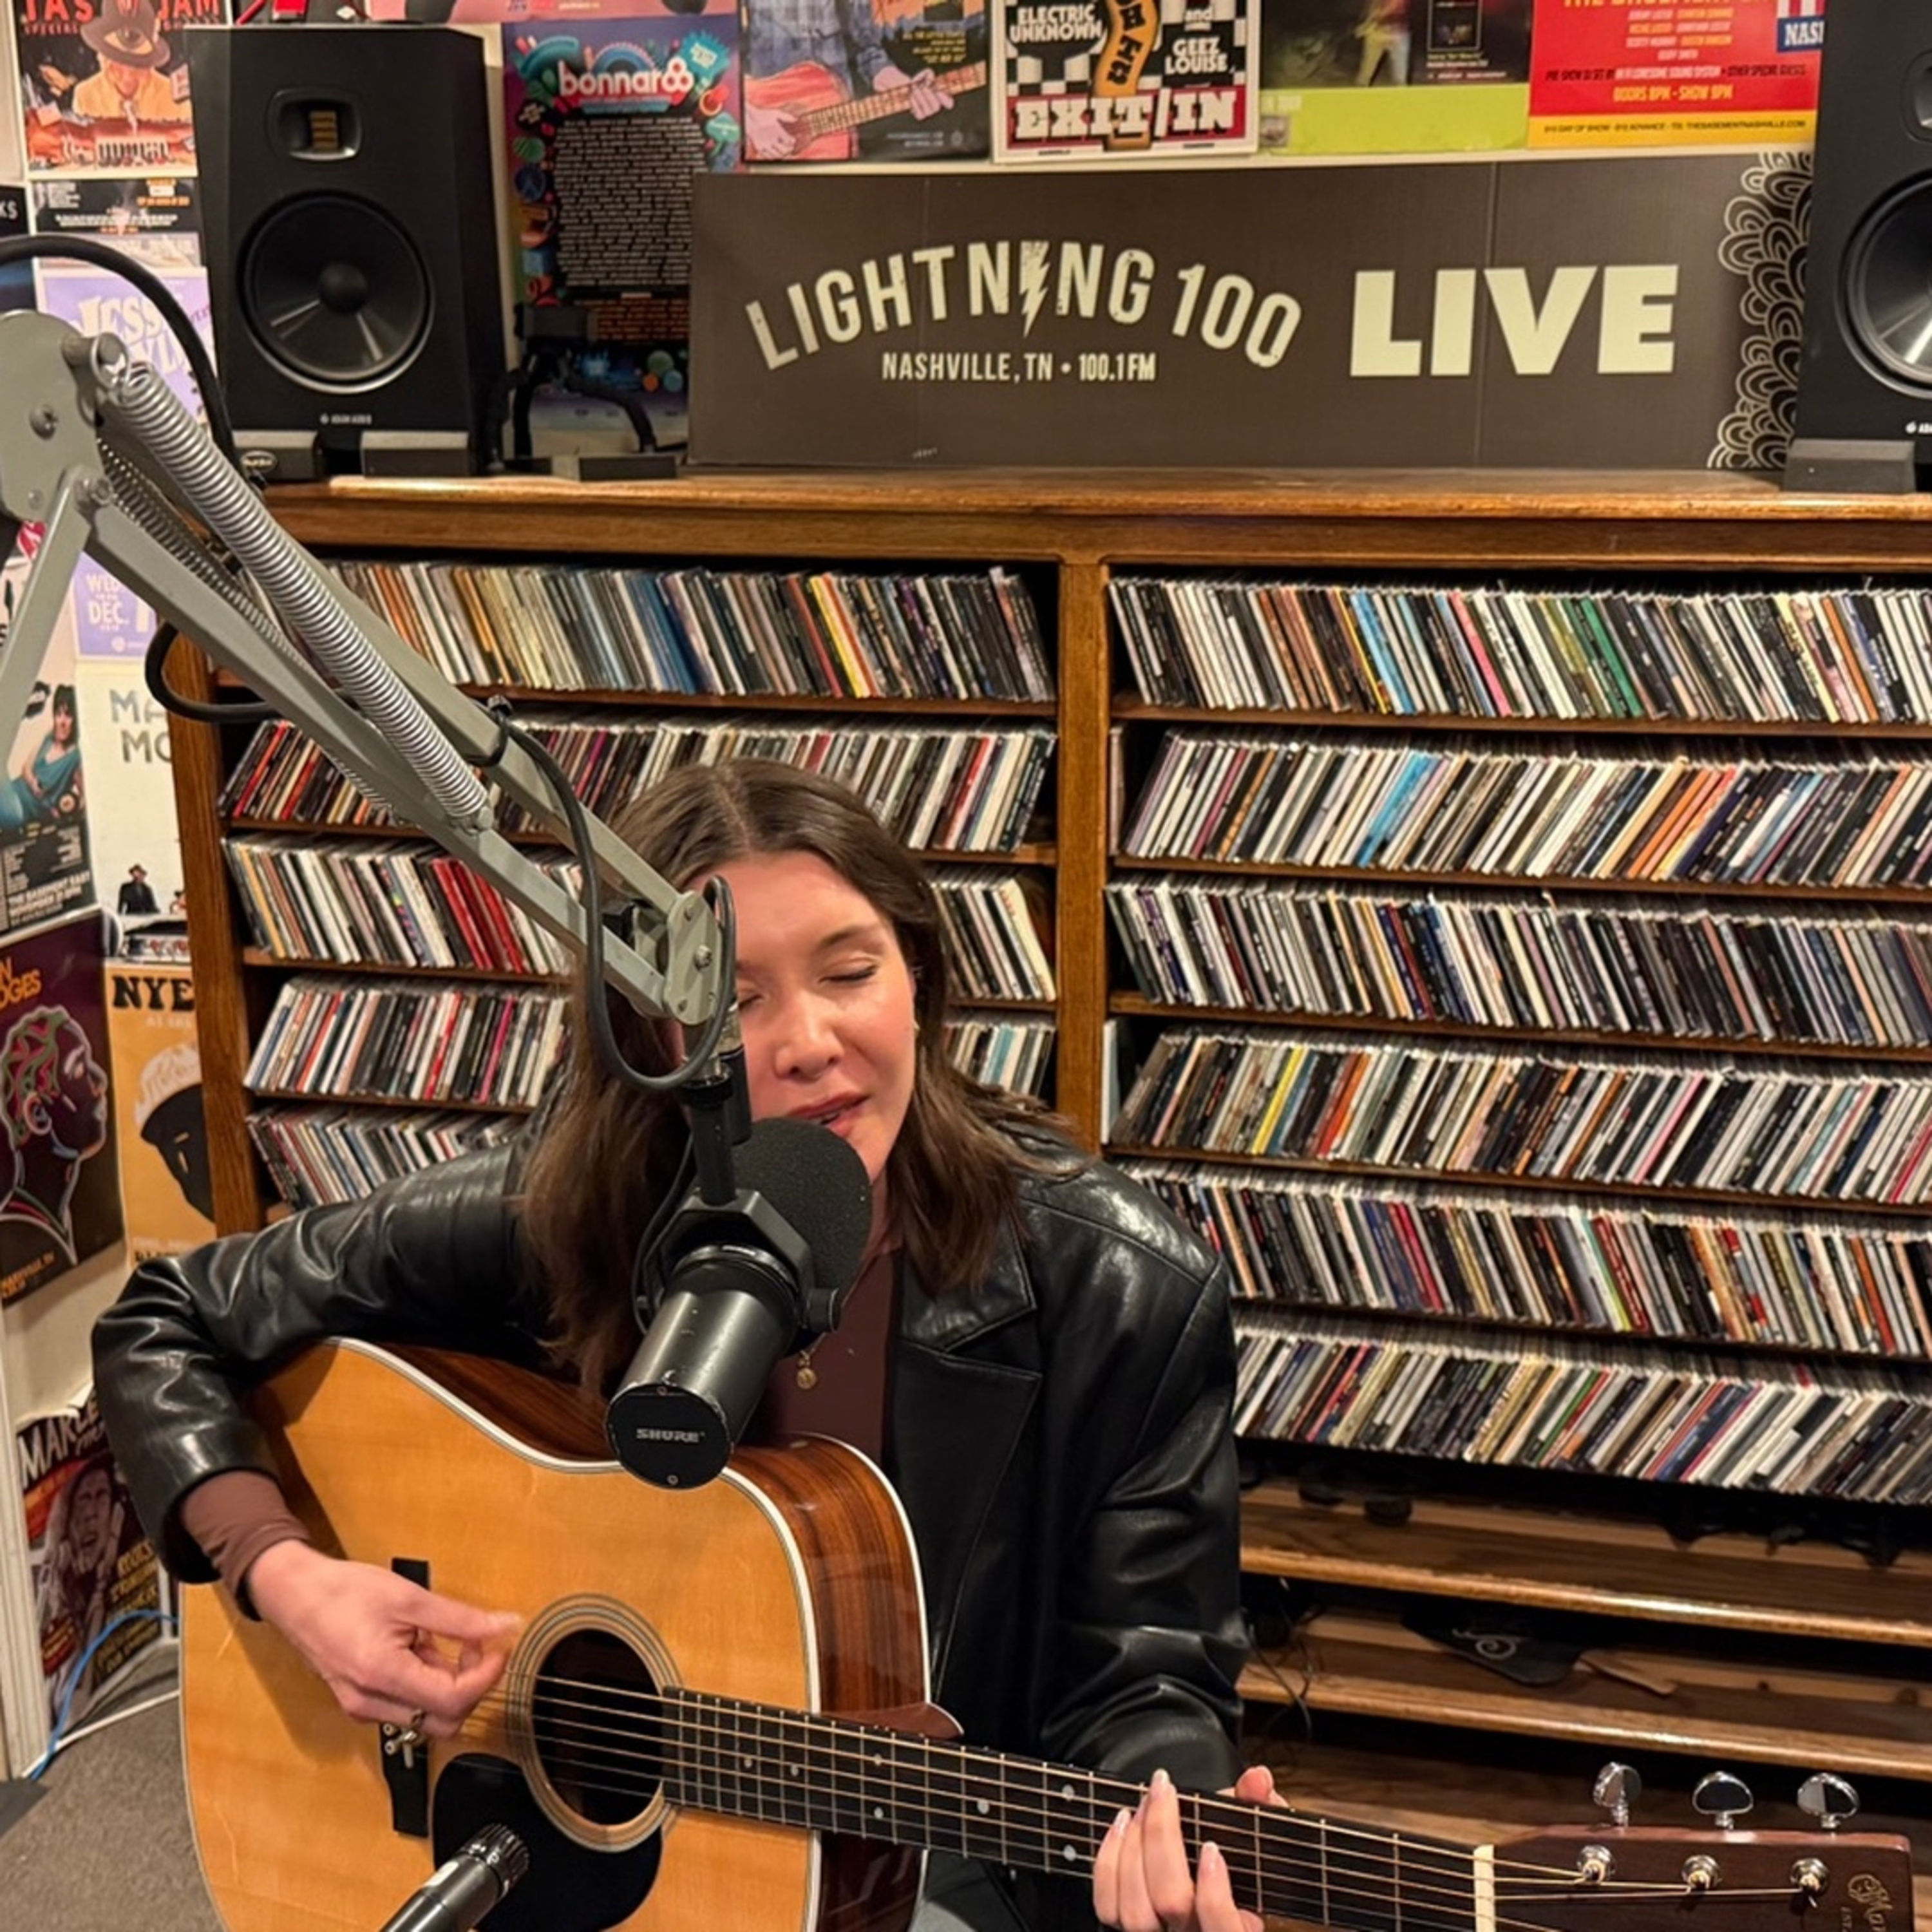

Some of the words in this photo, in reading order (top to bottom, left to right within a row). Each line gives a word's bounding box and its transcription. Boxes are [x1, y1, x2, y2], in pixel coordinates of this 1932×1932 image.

[1018, 5, 1095, 26] ELECTRIC
[1009, 19, 1103, 43] UNKNOWN
[1172, 37, 1221, 59] GEEZ
[1164, 52, 1229, 75] LOUISE
[1015, 90, 1237, 139] EXIT/IN
[745, 241, 1155, 371] LIGHTNING
[1171, 263, 1302, 368] 100
[1350, 263, 1678, 377] LIVE
[882, 352, 1021, 384] NASHVILLE,
[1023, 352, 1053, 381] TN
[111, 976, 195, 1012] NYE
[636, 1428, 699, 1443] SHURE
